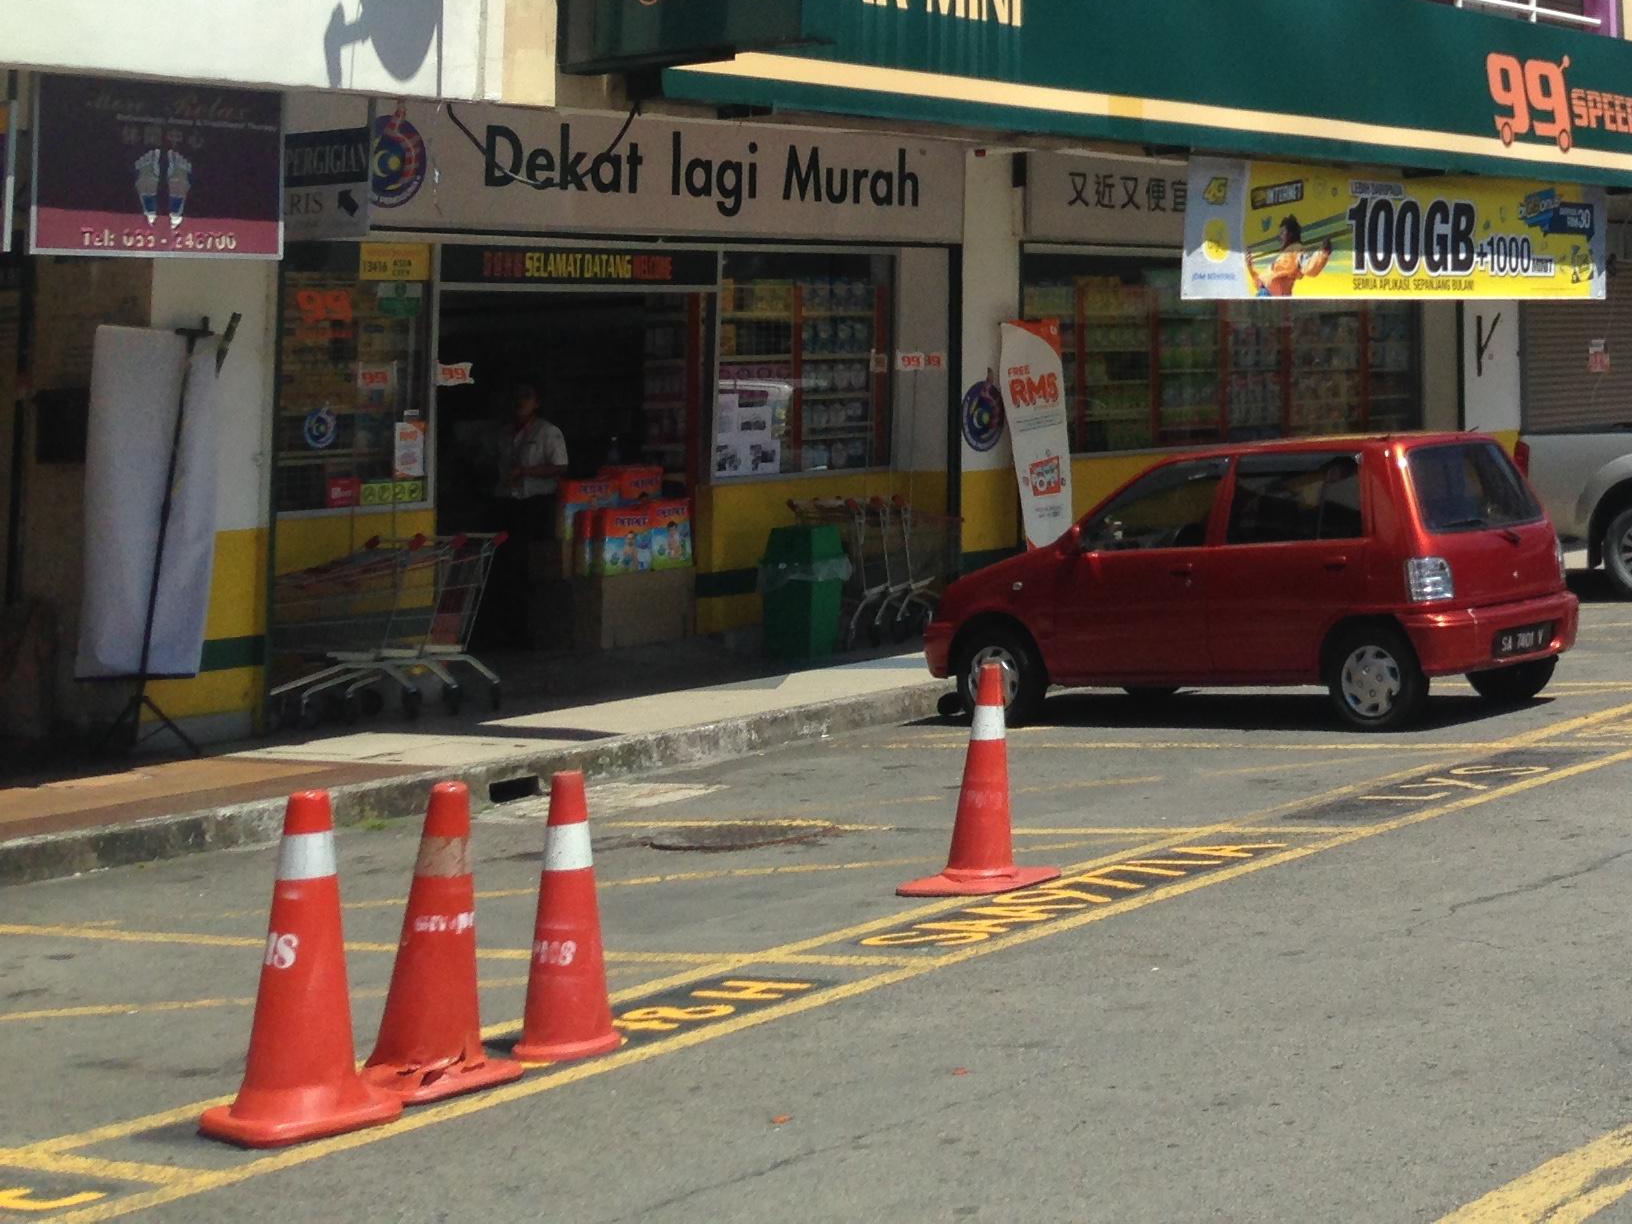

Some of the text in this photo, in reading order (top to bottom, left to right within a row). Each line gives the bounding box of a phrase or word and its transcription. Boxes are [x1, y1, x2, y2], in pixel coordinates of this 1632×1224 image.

[1486, 52, 1572, 154] 99
[485, 123, 643, 194] Dekat
[672, 130, 758, 217] lagi
[782, 143, 919, 207] Murah
[1068, 172, 1187, 212] 又近又便宜
[1203, 177, 1228, 205] 4G
[80, 227, 114, 247] Tel:
[525, 252, 582, 279] SELAMAT
[583, 254, 632, 280] DATANG
[1353, 277, 1377, 290] SEMUA
[1008, 365, 1031, 378] FREE
[1501, 635, 1512, 652] SA
